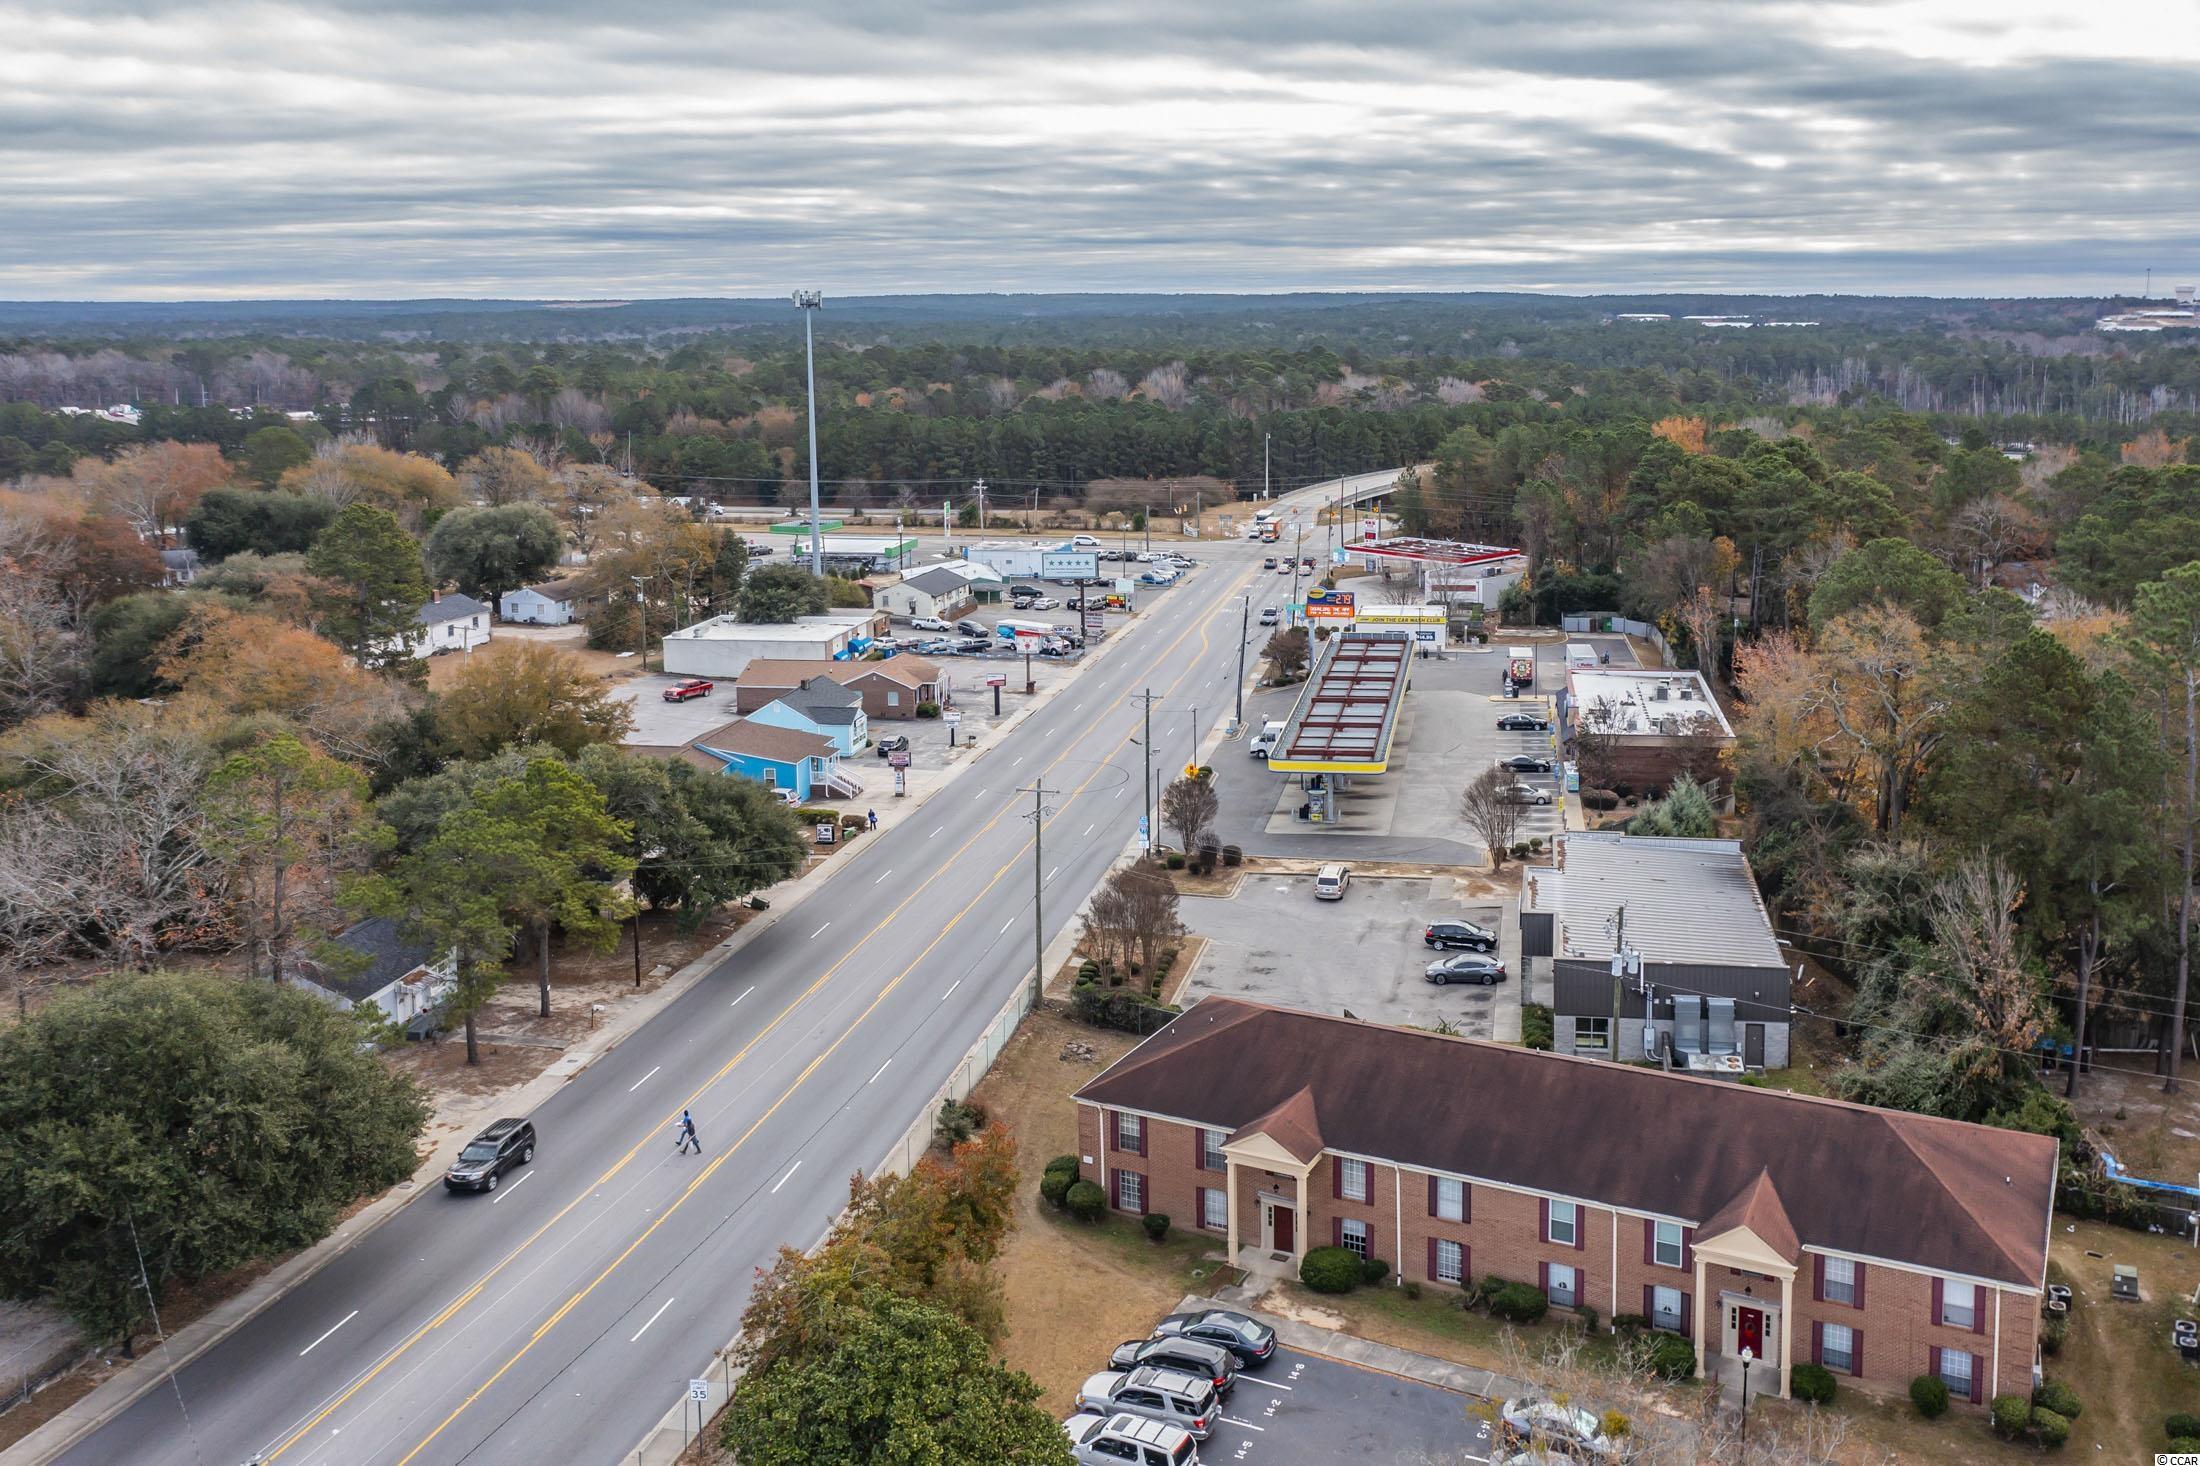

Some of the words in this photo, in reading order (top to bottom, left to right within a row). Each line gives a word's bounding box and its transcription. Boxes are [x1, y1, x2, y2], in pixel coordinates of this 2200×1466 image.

[692, 1390, 707, 1399] 35
[1264, 1399, 1281, 1417] 14-2
[1234, 1440, 1253, 1460] 14-5
